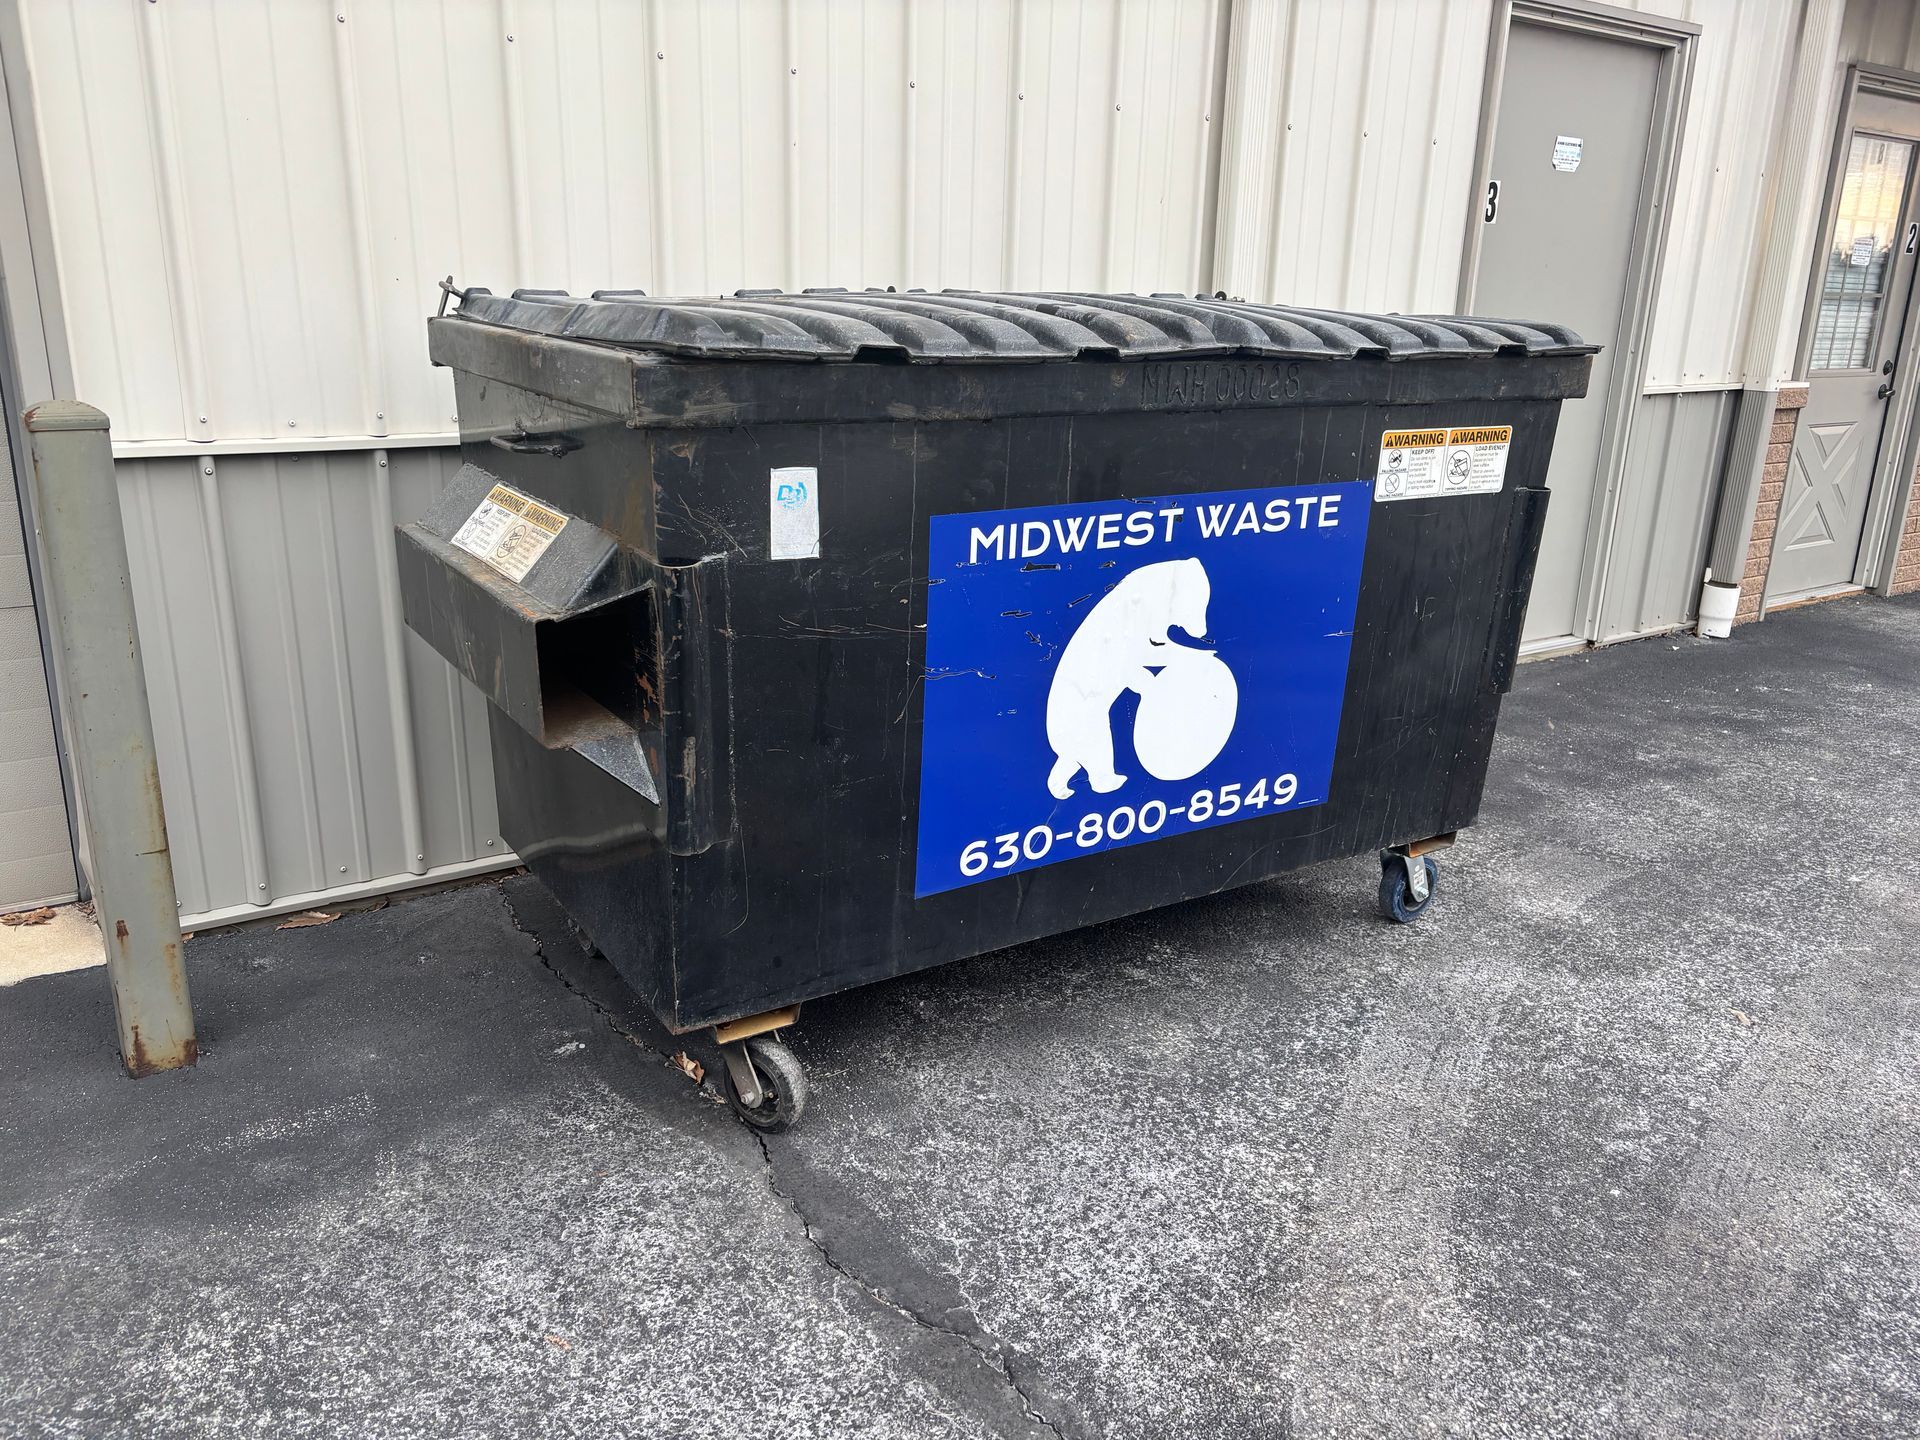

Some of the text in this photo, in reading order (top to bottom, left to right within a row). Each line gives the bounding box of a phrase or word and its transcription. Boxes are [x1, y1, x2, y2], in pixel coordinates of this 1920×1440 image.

[1485, 182, 1498, 222] 3
[1905, 223, 1918, 254] 2
[1141, 363, 1209, 405] MWH
[1394, 433, 1444, 447] WARNING
[1459, 430, 1508, 443] WARNING
[494, 489, 526, 513] WARNING
[527, 507, 563, 532] WARNING
[969, 494, 1342, 565] MIDWEST WASTE
[959, 773, 1298, 877] 630-800-8549
